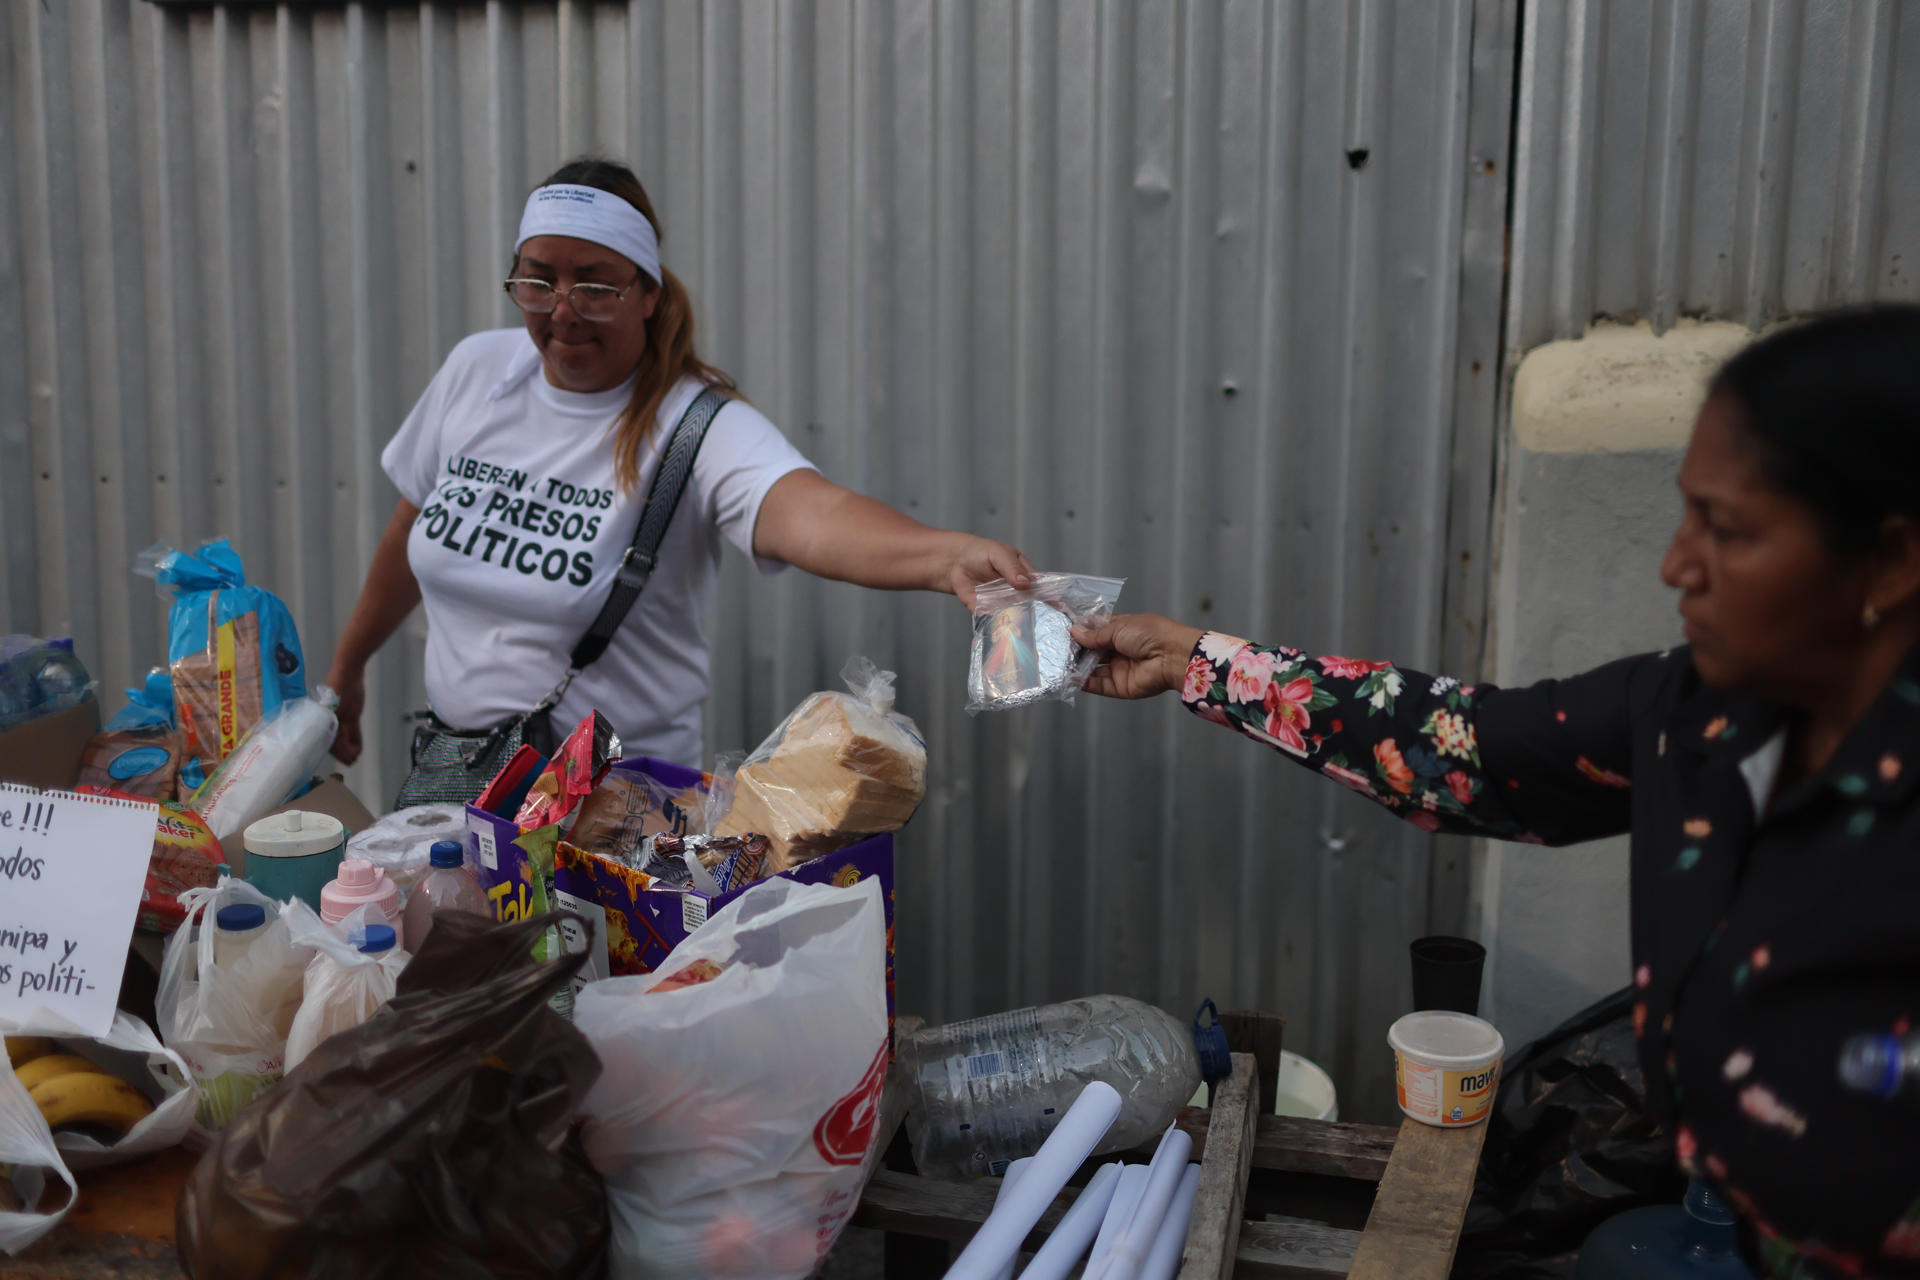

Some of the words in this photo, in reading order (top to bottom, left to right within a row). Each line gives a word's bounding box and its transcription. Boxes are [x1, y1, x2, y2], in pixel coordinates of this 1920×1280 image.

[571, 189, 595, 198] Libertad
[447, 456, 528, 492] LIBEREN
[546, 477, 614, 510] TODOS
[438, 480, 483, 508] LOS
[483, 491, 602, 543] PRESOS
[417, 502, 594, 587] POLÍTICOS
[219, 670, 233, 736] GRANDE
[19, 801, 54, 837] !!!
[157, 825, 196, 840] aker
[0, 925, 49, 955] nipa
[54, 939, 78, 966] y
[18, 962, 96, 998] políti-
